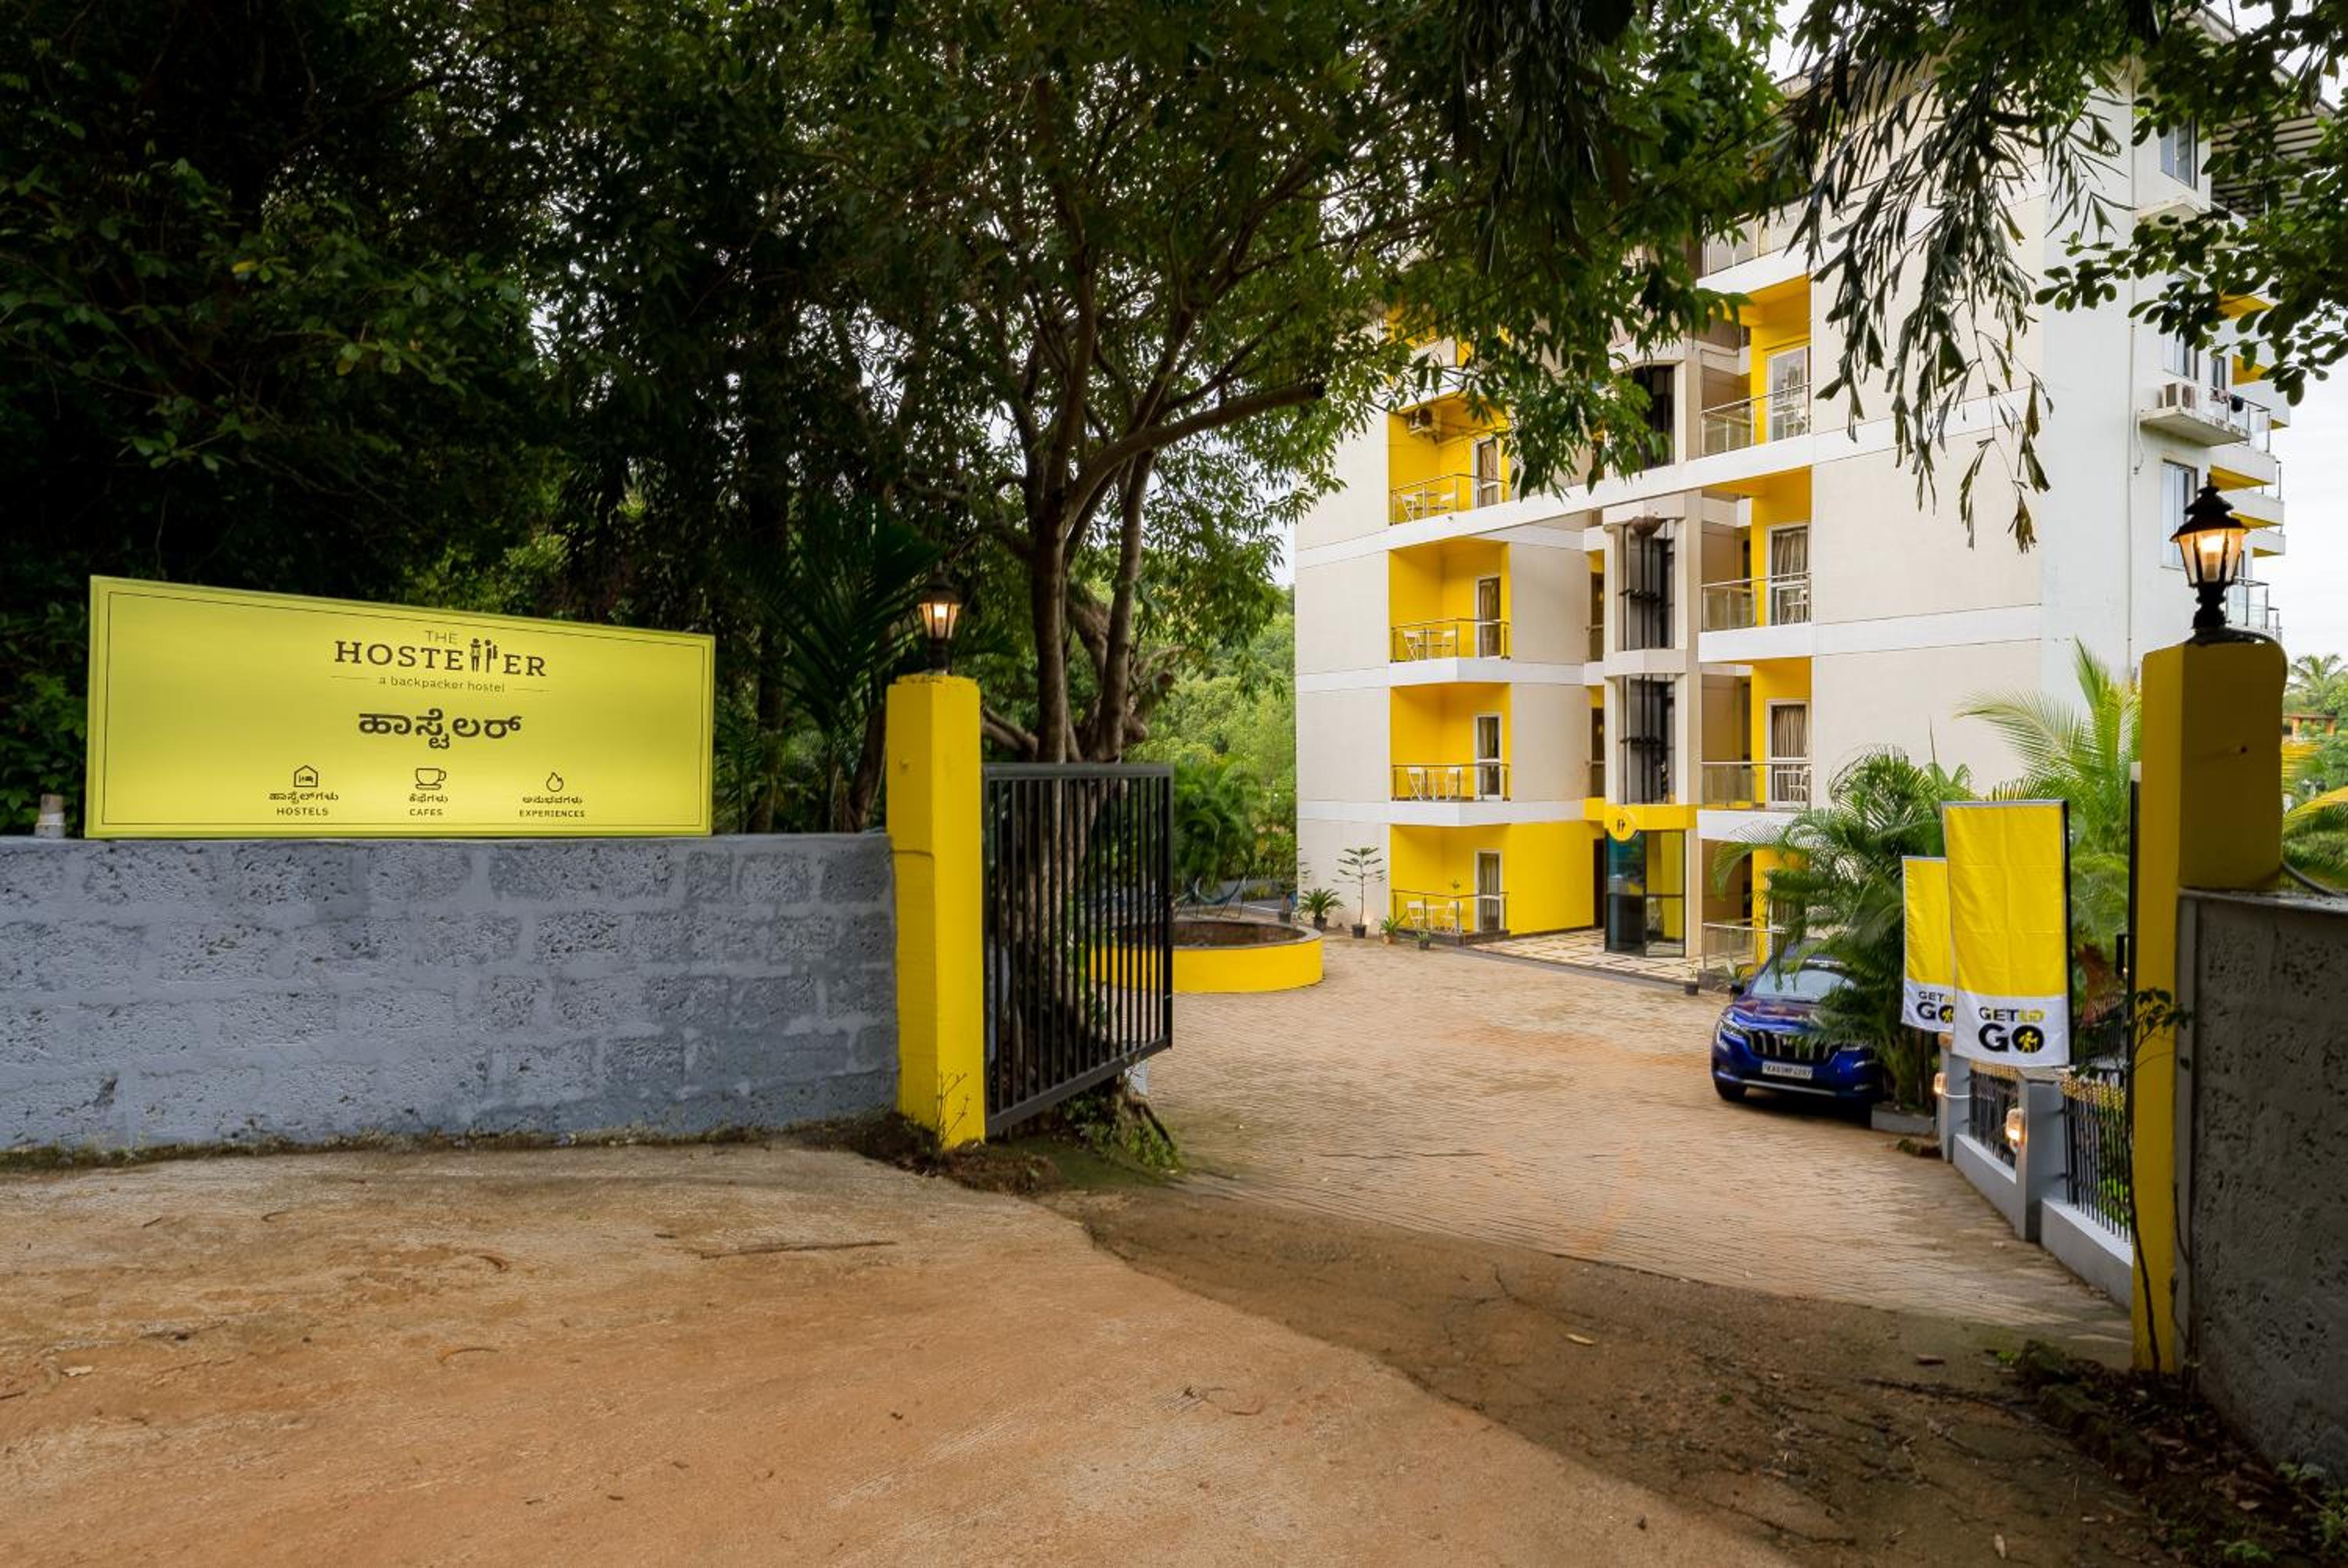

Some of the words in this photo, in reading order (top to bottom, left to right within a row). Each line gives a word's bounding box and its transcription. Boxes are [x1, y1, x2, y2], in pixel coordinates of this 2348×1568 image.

[425, 630, 459, 645] THE
[391, 675, 463, 689] backpacker
[468, 682, 505, 692] hostel
[276, 807, 329, 816] HOSTELS
[519, 809, 585, 818] EXPERIENCES
[1978, 1023, 2044, 1053] GO
